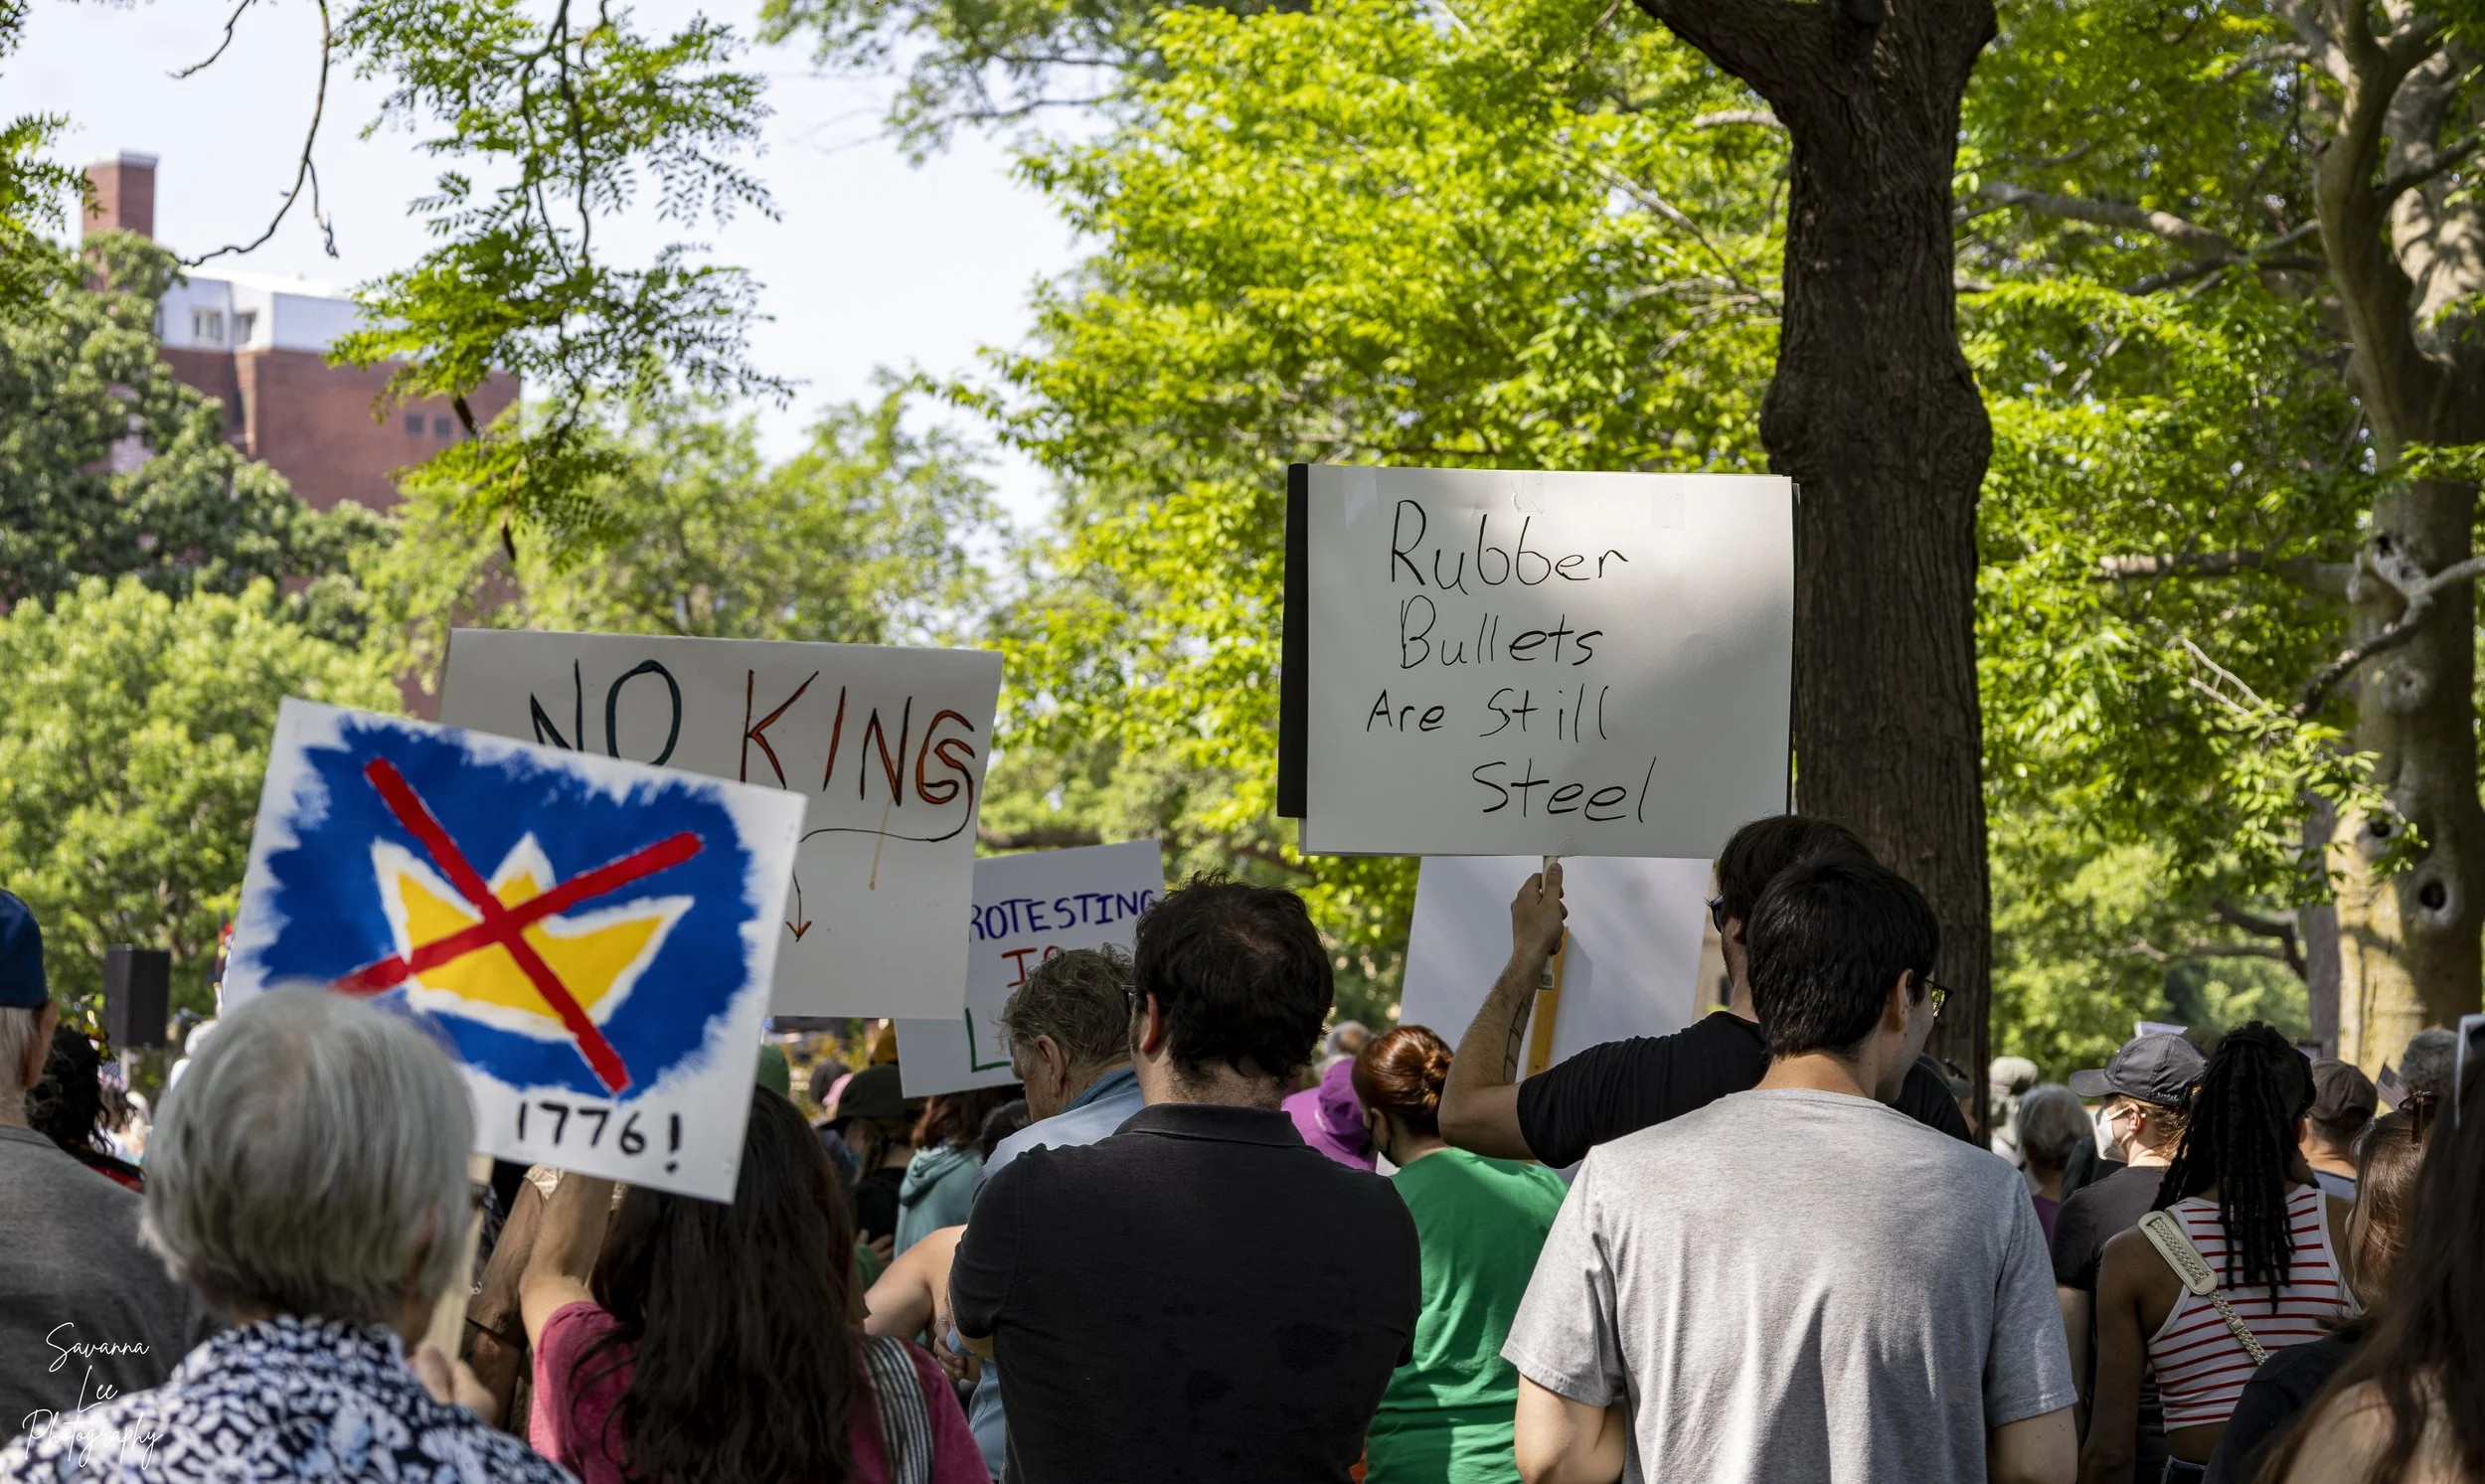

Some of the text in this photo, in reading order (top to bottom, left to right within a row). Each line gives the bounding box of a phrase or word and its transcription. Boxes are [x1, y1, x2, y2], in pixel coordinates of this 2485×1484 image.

[1391, 499, 1629, 594] Rubber
[1400, 594, 1603, 669] Bullets
[529, 658, 682, 766] NO
[1366, 683, 1609, 741] Are Still
[1472, 755, 1657, 823] Steel
[968, 890, 1154, 943] ROTESTIN
[517, 1100, 684, 1173] 1776!
